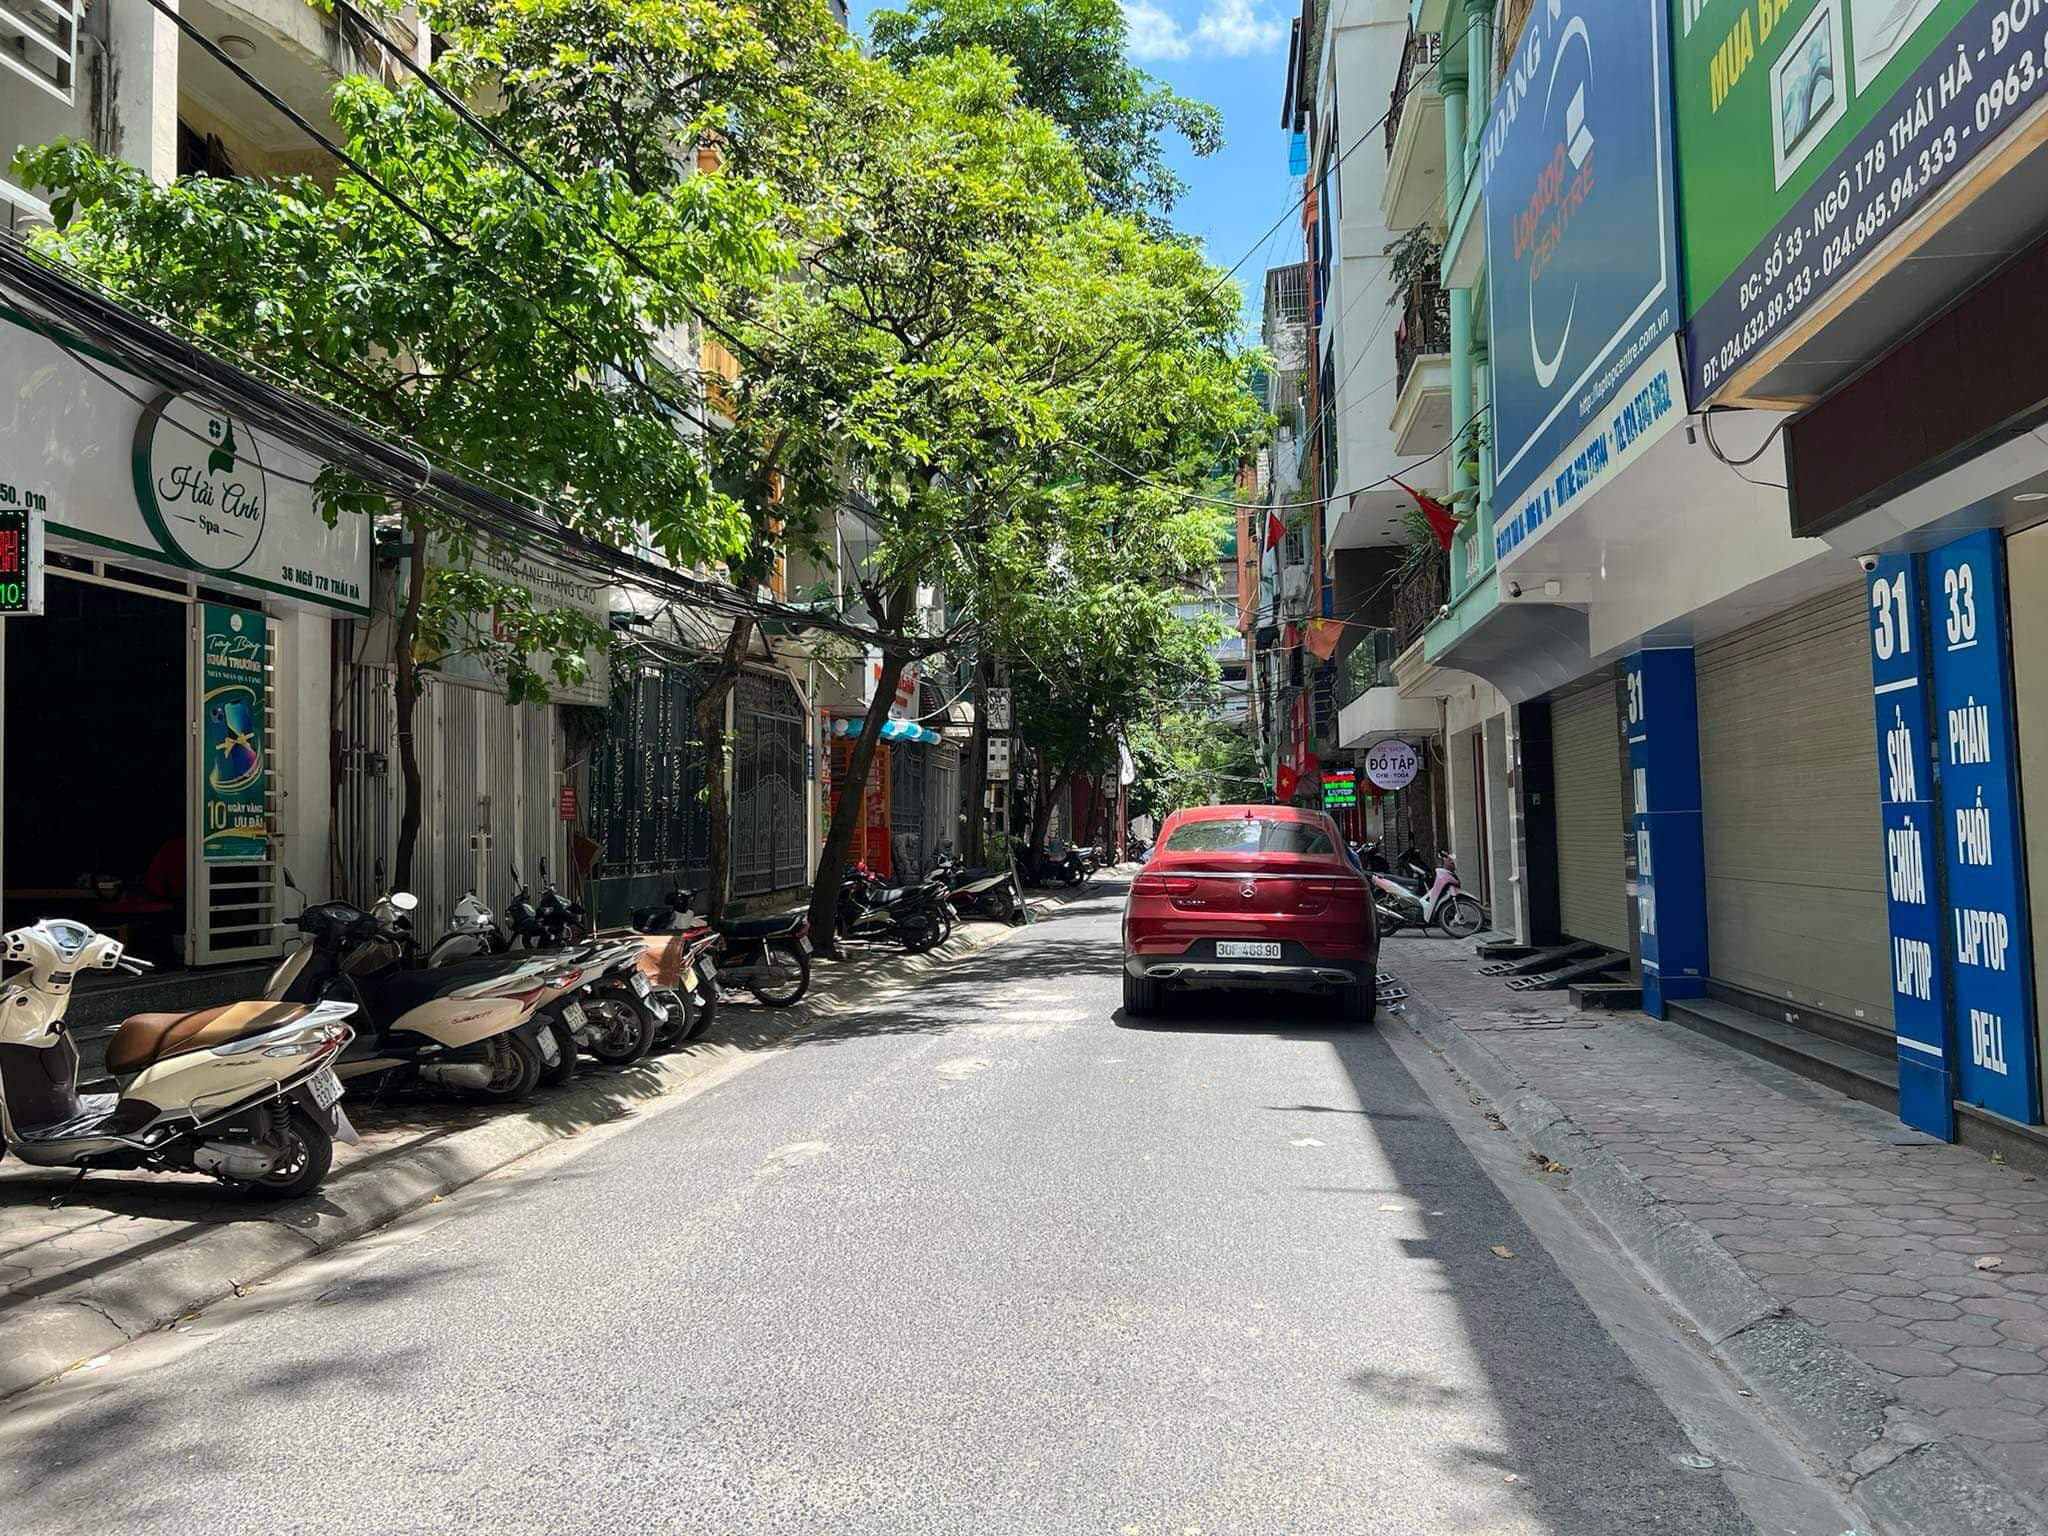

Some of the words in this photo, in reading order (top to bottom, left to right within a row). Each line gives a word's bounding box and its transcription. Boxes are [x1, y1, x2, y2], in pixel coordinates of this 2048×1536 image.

[1710, 7, 1754, 114] MUA
[1483, 25, 1541, 185] HOÀNG
[1740, 273, 1762, 312] ĐC:
[1765, 232, 1783, 287] SỐ
[1786, 226, 1802, 264] 33
[1814, 170, 1850, 237] NGÕ
[1855, 140, 1886, 192] 178
[1889, 86, 1934, 158] THÁI
[1939, 44, 1973, 109] HÀ
[1532, 149, 1595, 282] CENTRE
[1703, 355, 1719, 389] ĐT:
[1720, 265, 1811, 372] 024.632.89.333
[1823, 126, 1957, 276] 024.665.94.333
[159, 465, 214, 506] Hải
[222, 481, 260, 521] Anh
[199, 514, 220, 535] Spa
[281, 565, 293, 582] 36
[295, 568, 313, 587] NGÕ
[315, 575, 329, 591] 178
[330, 579, 348, 597] THÁI
[349, 583, 360, 600] HÀ
[521, 563, 544, 587] ANH
[577, 584, 597, 605] CAO
[1872, 570, 1911, 661] 31
[1944, 563, 1977, 645] 33
[1627, 669, 1644, 724] 31
[1948, 695, 1991, 765] PHÂN
[1390, 754, 1415, 773] TẬP
[1887, 704, 1918, 803] SỬA
[207, 799, 227, 829] 10
[1956, 785, 1993, 866] PHỐI
[1888, 815, 1926, 905] CHỮA
[1894, 936, 1932, 1001] LAPTOP
[1955, 907, 2009, 971] LAPTOP
[1970, 1008, 2008, 1076] DELL
